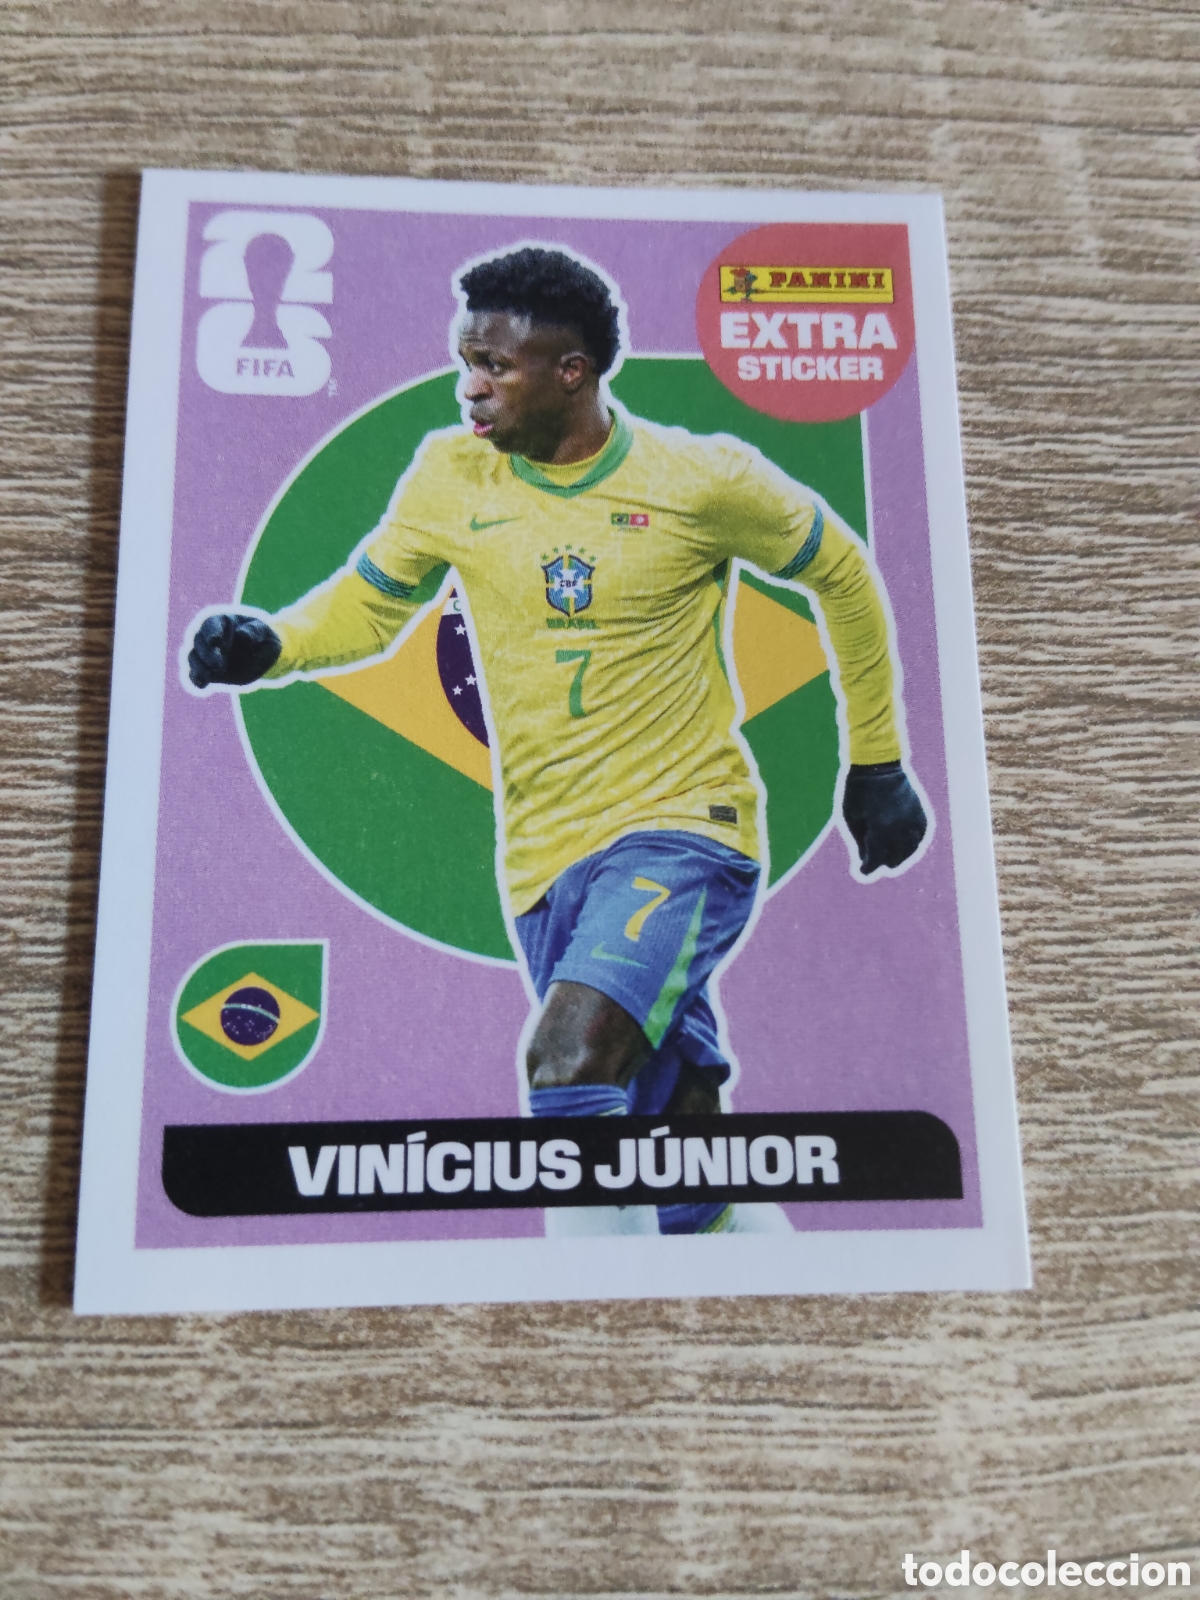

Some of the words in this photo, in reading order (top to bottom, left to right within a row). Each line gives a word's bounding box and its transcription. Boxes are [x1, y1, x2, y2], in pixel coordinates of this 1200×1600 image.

[769, 271, 885, 289] PANINI
[720, 312, 898, 350] EXTRA
[236, 358, 295, 378] FIFA
[737, 355, 884, 381] STICKER
[555, 649, 592, 719] 7
[624, 876, 672, 942] 7
[288, 1132, 583, 1197] VINÍCIUS
[594, 1126, 841, 1191] JÚNIOR
